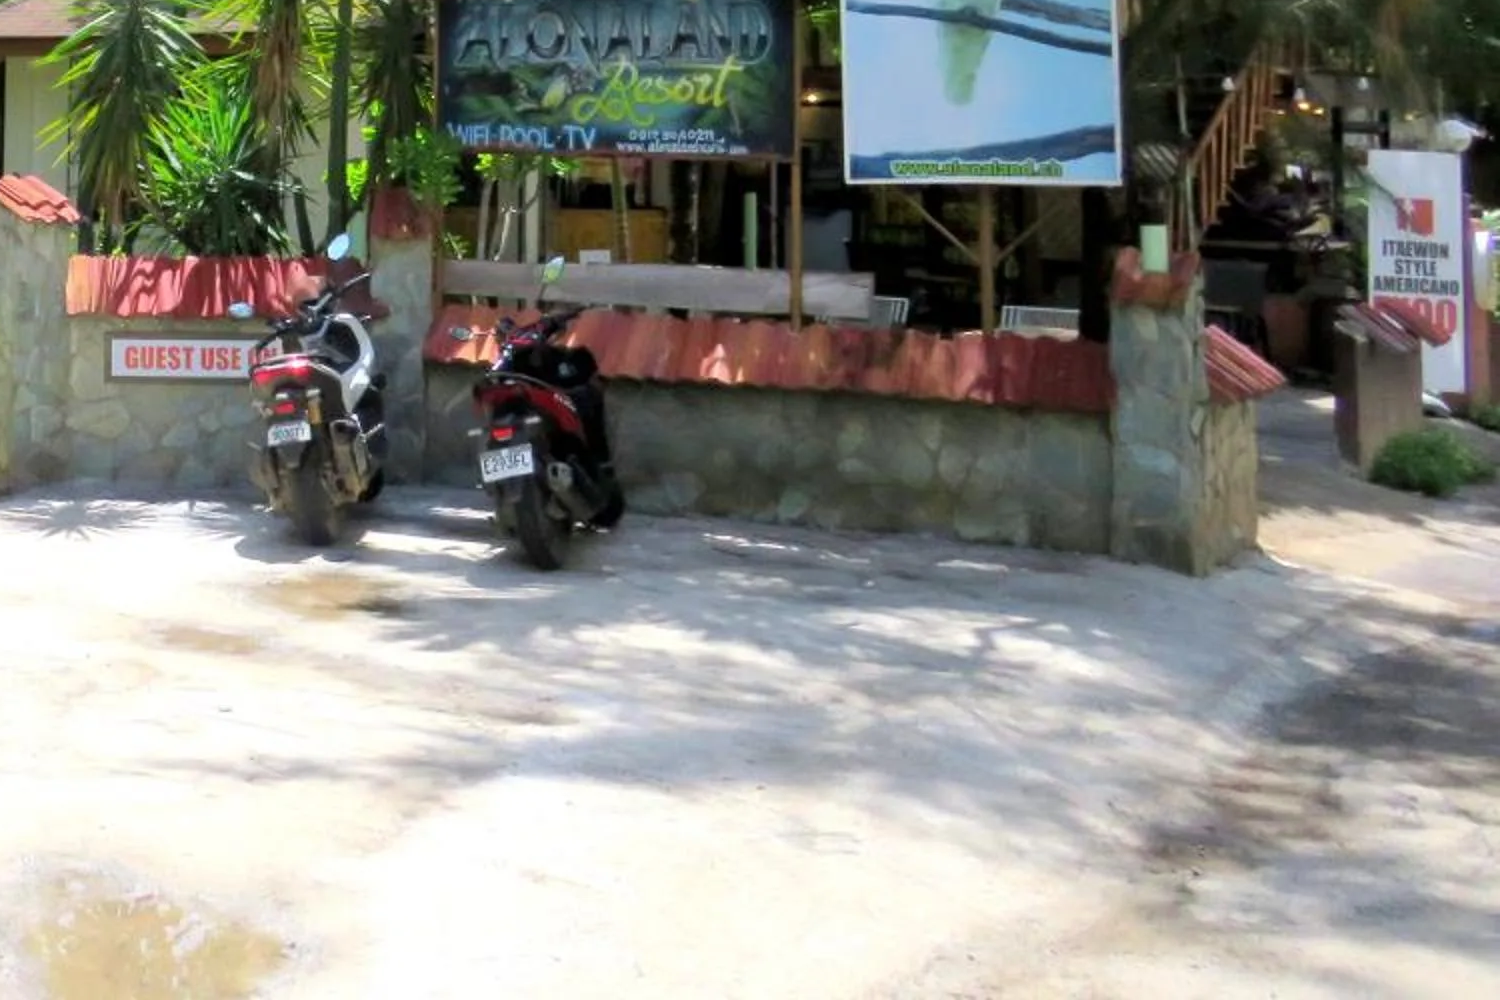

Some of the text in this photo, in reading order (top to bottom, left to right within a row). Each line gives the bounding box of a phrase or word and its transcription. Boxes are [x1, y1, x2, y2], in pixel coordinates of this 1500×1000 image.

[454, 2, 773, 69] ALONALAND
[573, 55, 743, 125] Resort
[1381, 240, 1449, 259] ITAEWON
[1394, 259, 1437, 276] STYLE
[1373, 276, 1460, 295] AMERICANO
[124, 345, 194, 370] GUEST
[202, 347, 242, 370] USE
